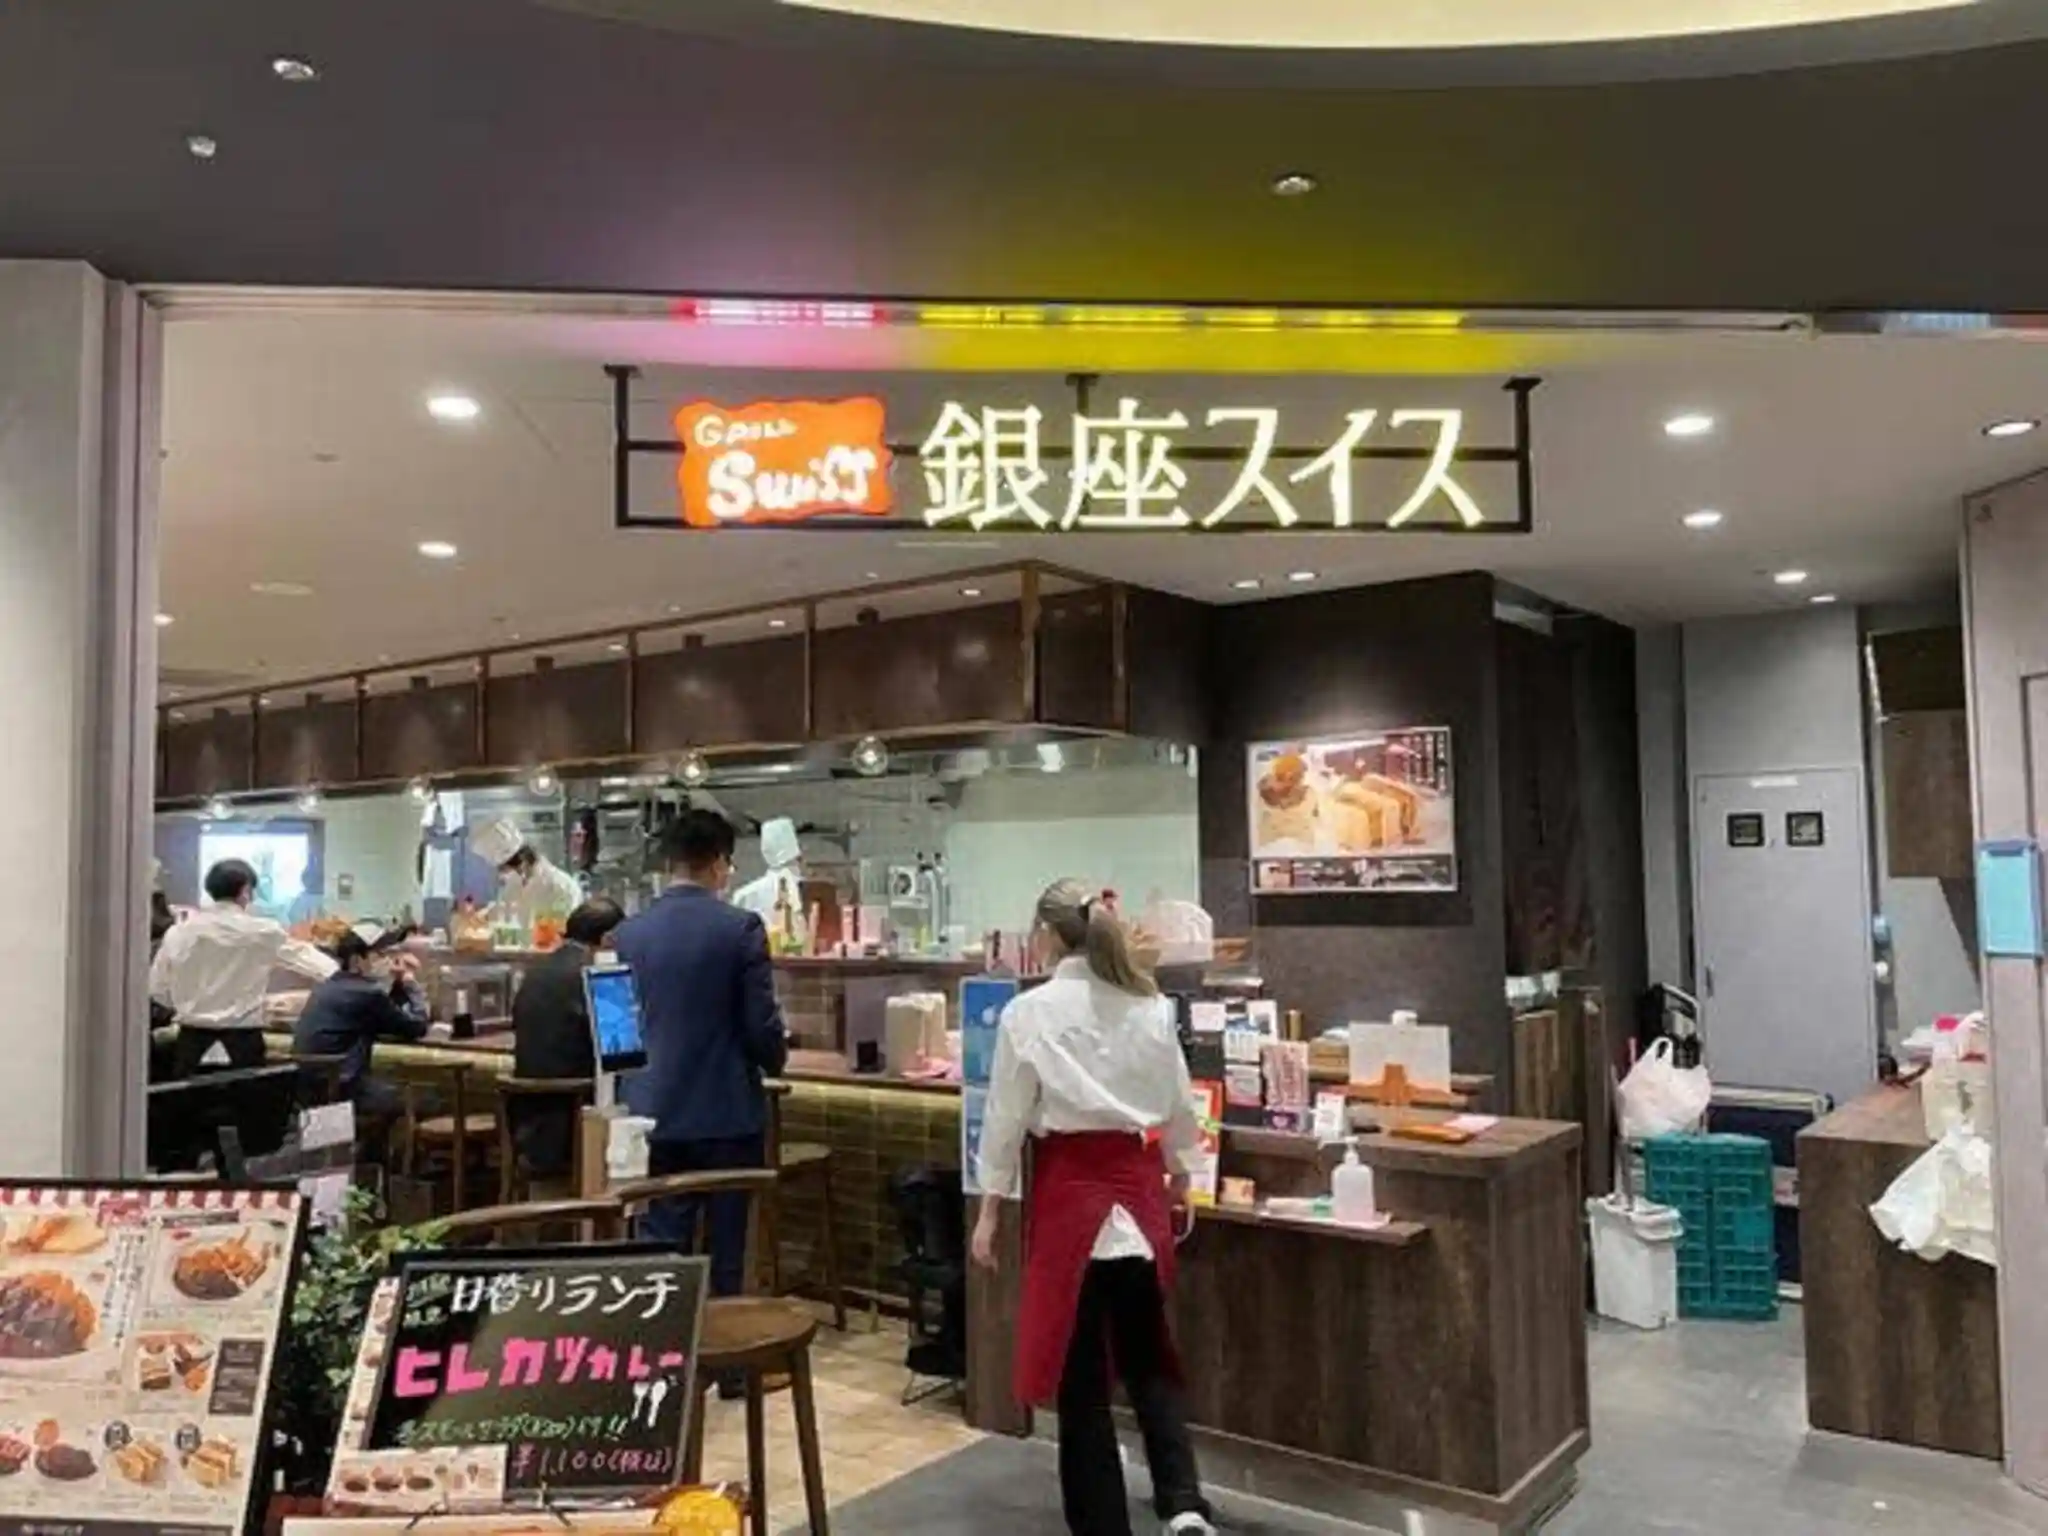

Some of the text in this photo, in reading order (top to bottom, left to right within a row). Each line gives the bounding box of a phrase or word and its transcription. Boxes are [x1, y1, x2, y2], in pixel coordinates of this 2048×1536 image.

[919, 399, 1484, 530] 銀座スイス
